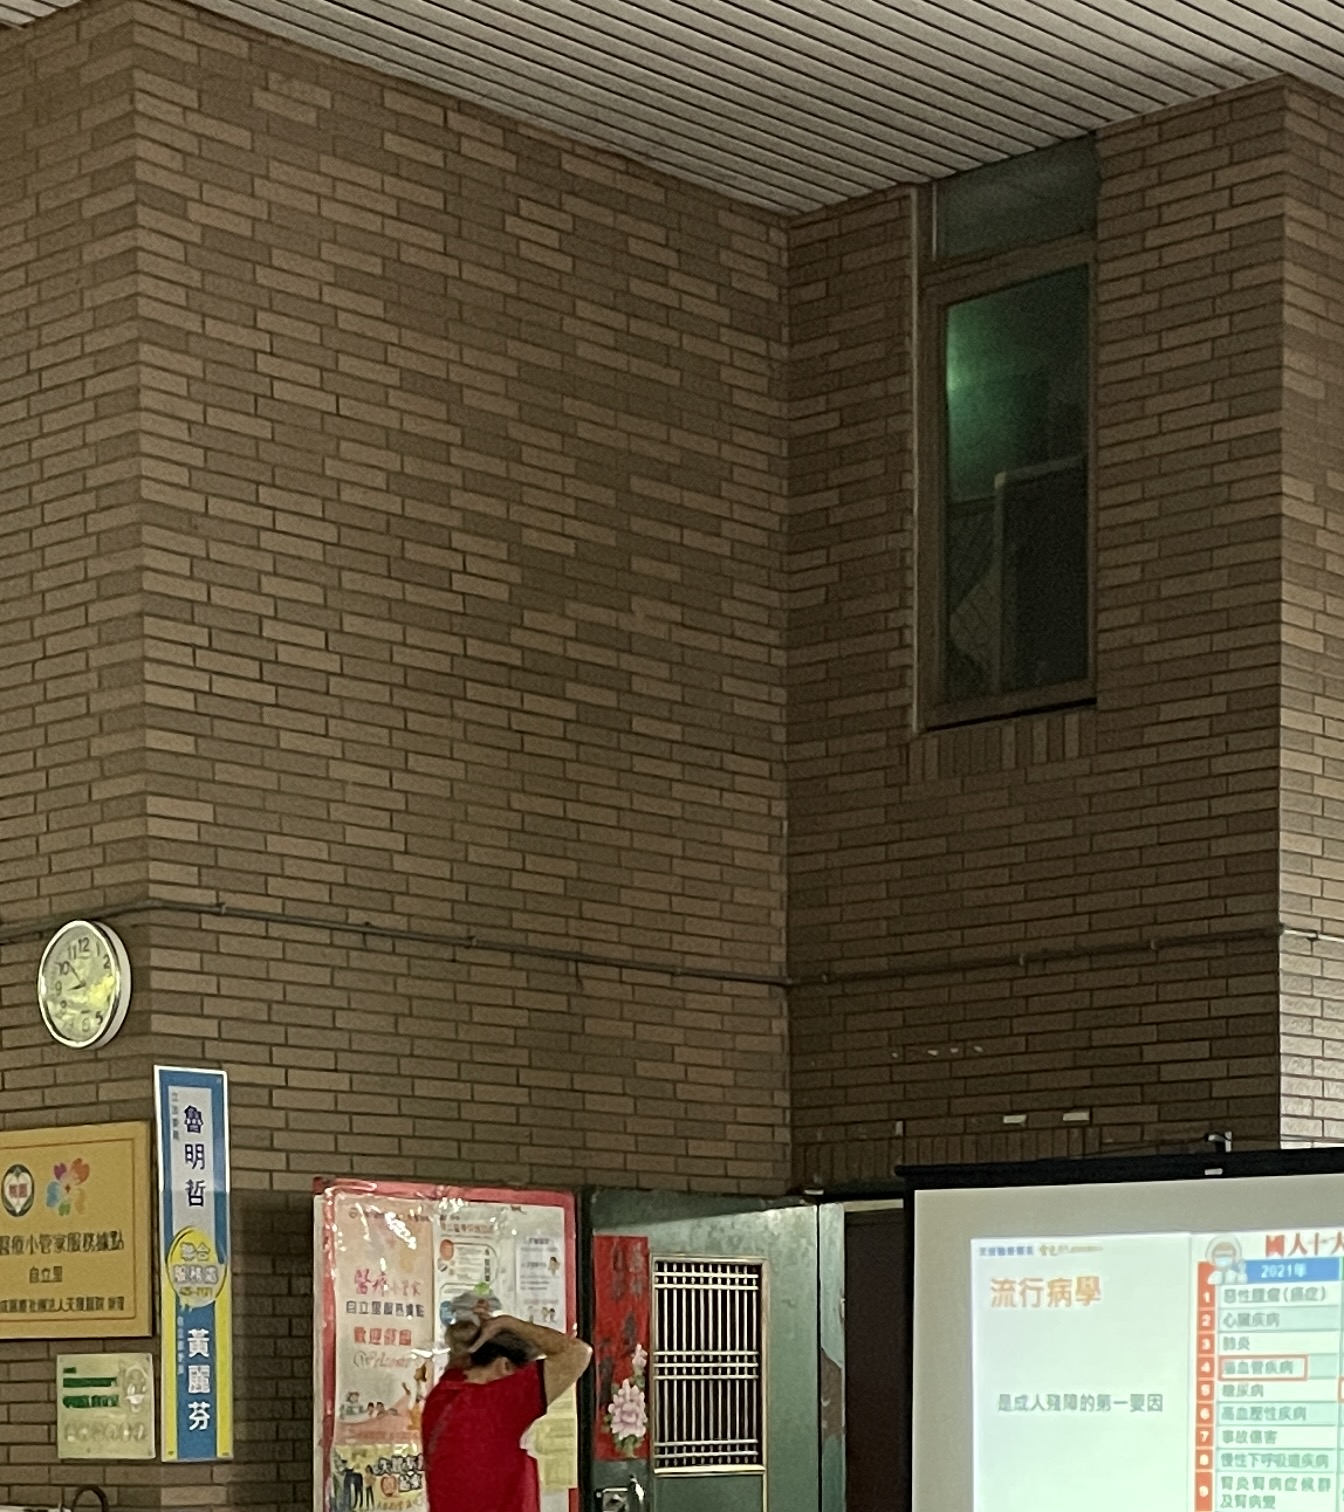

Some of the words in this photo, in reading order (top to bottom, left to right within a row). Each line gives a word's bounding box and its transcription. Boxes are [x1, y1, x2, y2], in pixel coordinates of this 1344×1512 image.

[78, 937, 90, 952] 12
[103, 955, 111, 970] 2
[96, 1011, 103, 1025] 5
[184, 1105, 206, 1206] 魯明哲
[29, 1266, 63, 1284] 自立里
[1261, 1262, 1306, 1279] 2021年
[991, 1276, 1101, 1308] 流行病學
[1202, 1316, 1210, 1326] 2
[1223, 1313, 1280, 1328] 心臟疾病
[1202, 1339, 1210, 1349] 3
[1223, 1336, 1250, 1351] 肺炎
[1201, 1362, 1210, 1373] 4
[1224, 1360, 1294, 1375] 腦血管疾病
[187, 1329, 211, 1431] 黃麗芬
[1201, 1386, 1210, 1396] 5
[1222, 1384, 1264, 1398] 糖尿病
[998, 1394, 1163, 1412] 是成人殘障的第一要因
[1200, 1409, 1210, 1419] 6
[1222, 1406, 1307, 1421] 高血壓性疾病
[1200, 1431, 1209, 1442] 7
[1222, 1430, 1278, 1444] 事故傷害
[1220, 1453, 1329, 1469] 慢性下呼吸道疾病
[1221, 1476, 1331, 1492] 腎炎腎病症候群
[1220, 1495, 1276, 1509] 及腎病變
